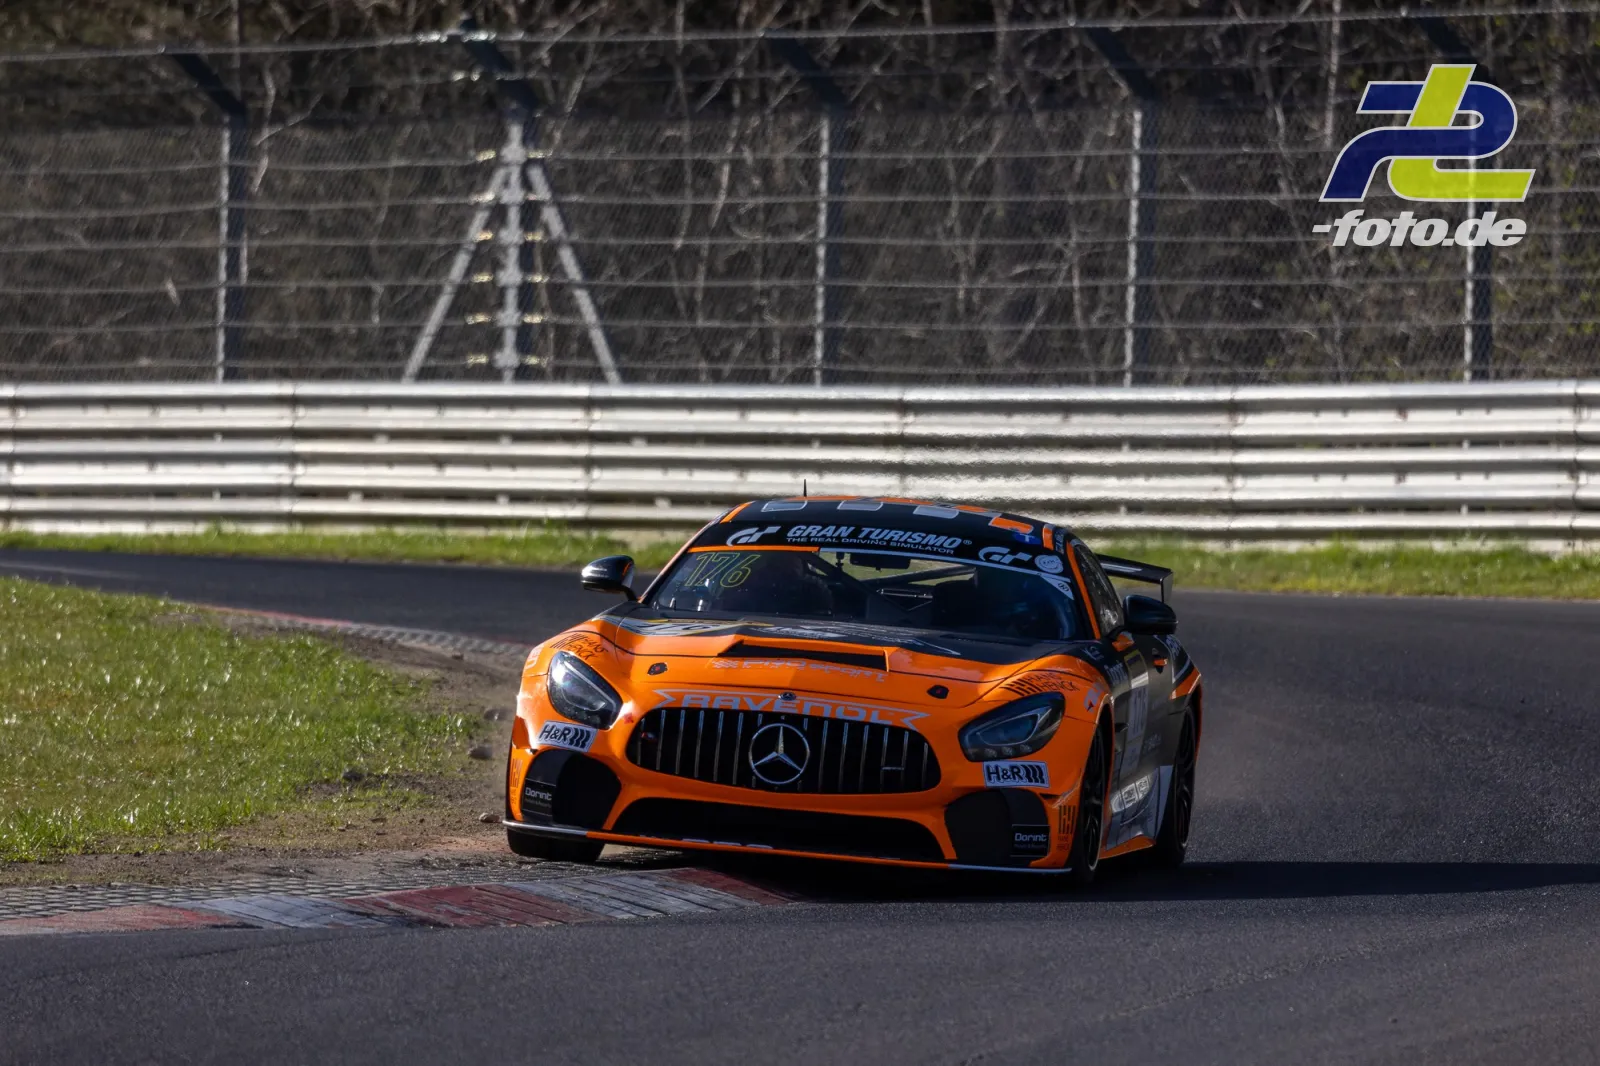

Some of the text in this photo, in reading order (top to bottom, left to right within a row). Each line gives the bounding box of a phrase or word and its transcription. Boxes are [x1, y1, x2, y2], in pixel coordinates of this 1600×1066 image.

[786, 525, 856, 537] GRAN
[841, 538, 887, 546] DRIVING
[889, 542, 955, 555] SIMULATOR
[684, 552, 762, 588] 176
[682, 694, 894, 725] RAVENOL
[539, 724, 572, 742] H&R
[986, 764, 1024, 782] H&R
[525, 786, 553, 801] Dorint
[1014, 832, 1048, 842] Dorint
